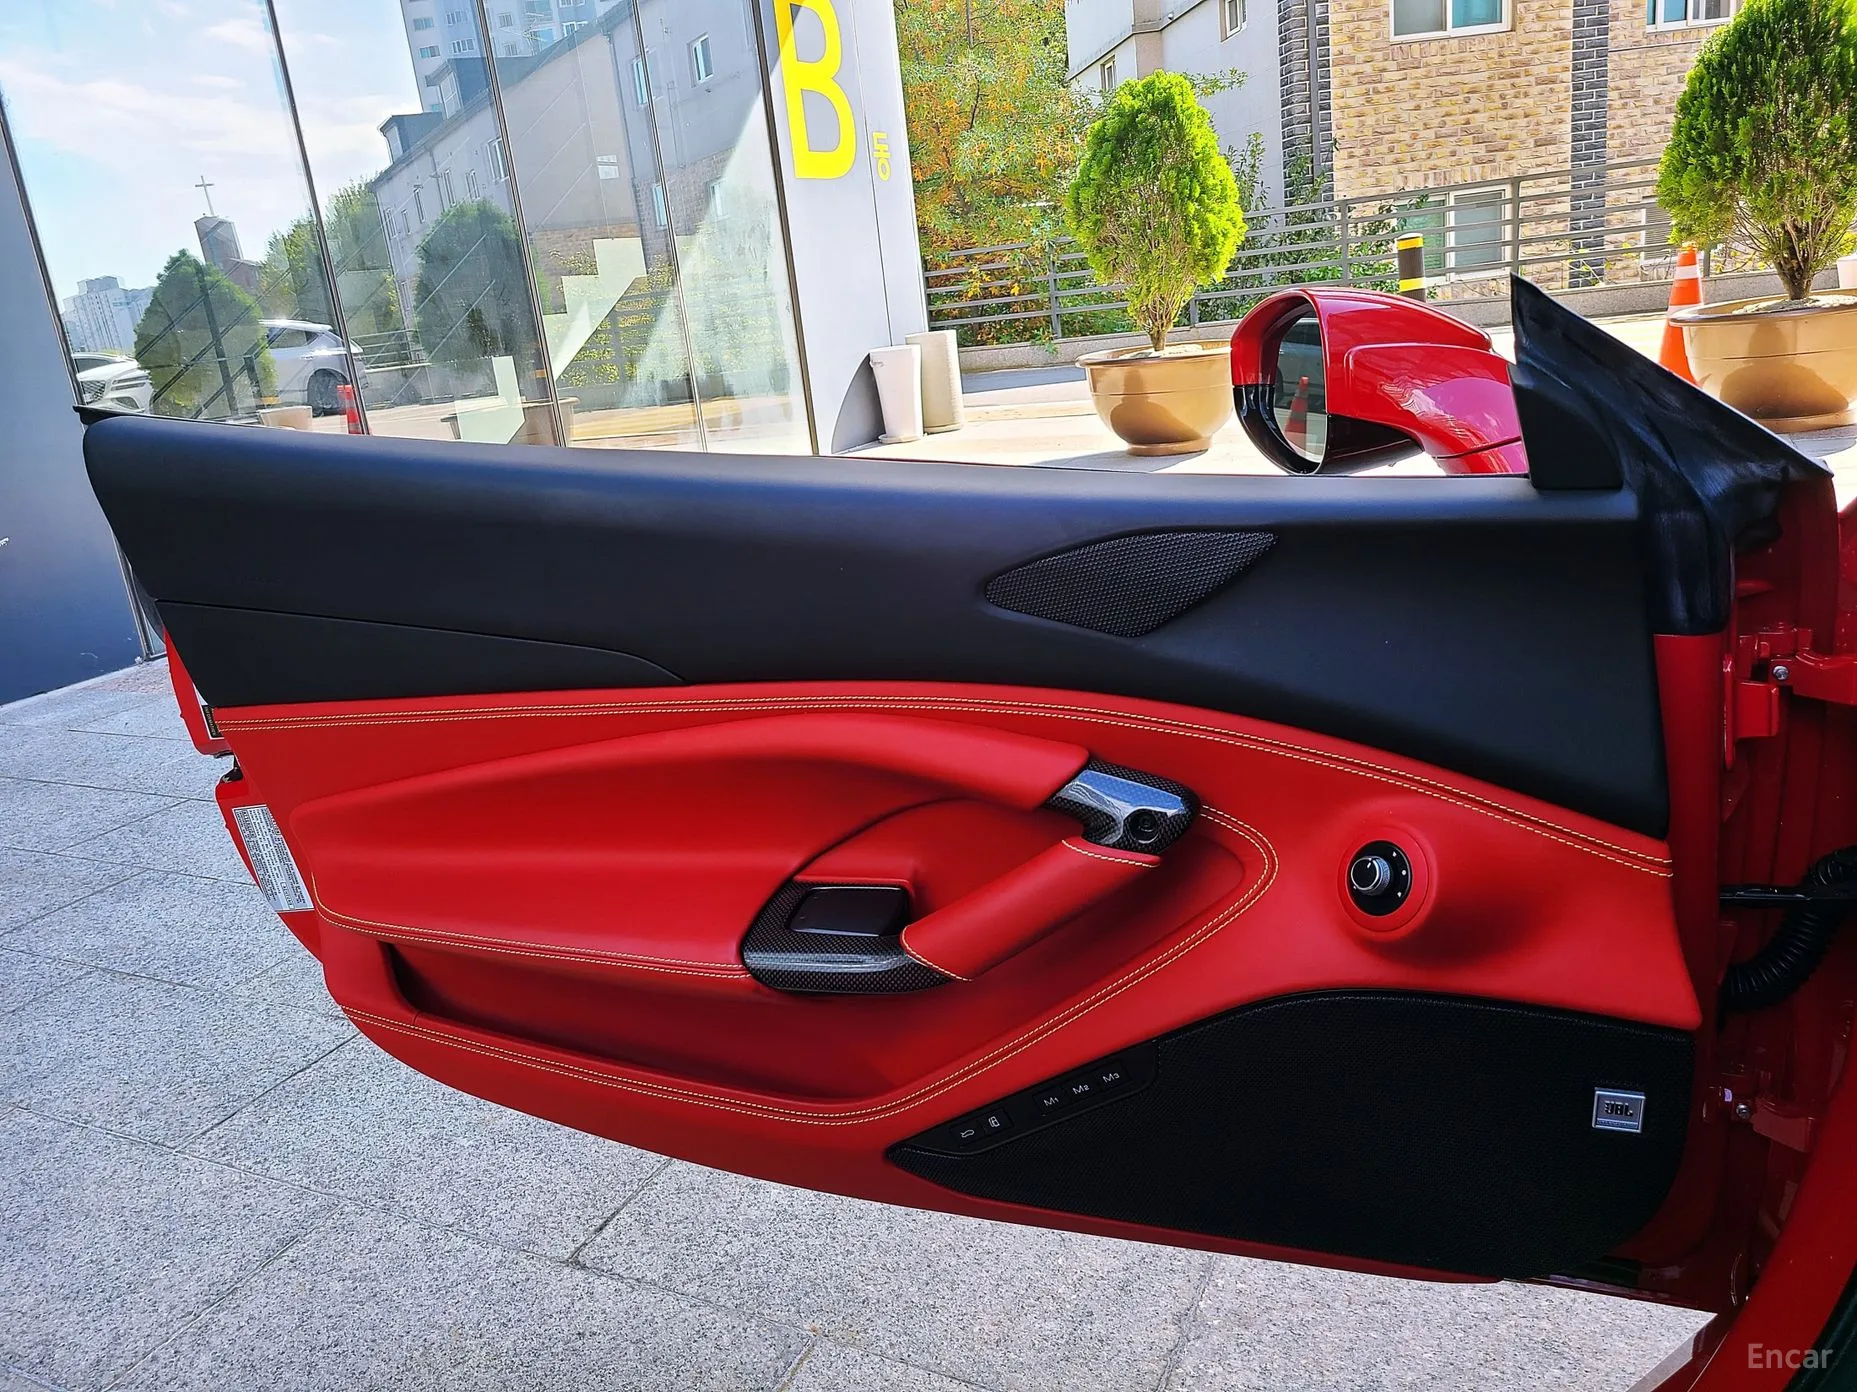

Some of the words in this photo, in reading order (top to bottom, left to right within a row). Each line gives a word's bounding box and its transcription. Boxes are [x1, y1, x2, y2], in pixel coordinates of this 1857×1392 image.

[773, 0, 857, 179] B
[872, 131, 892, 182] 동
[1043, 1096, 1060, 1107] M1
[1072, 1084, 1090, 1095] M2
[1102, 1072, 1120, 1083] M3
[1604, 1100, 1633, 1117] JBL
